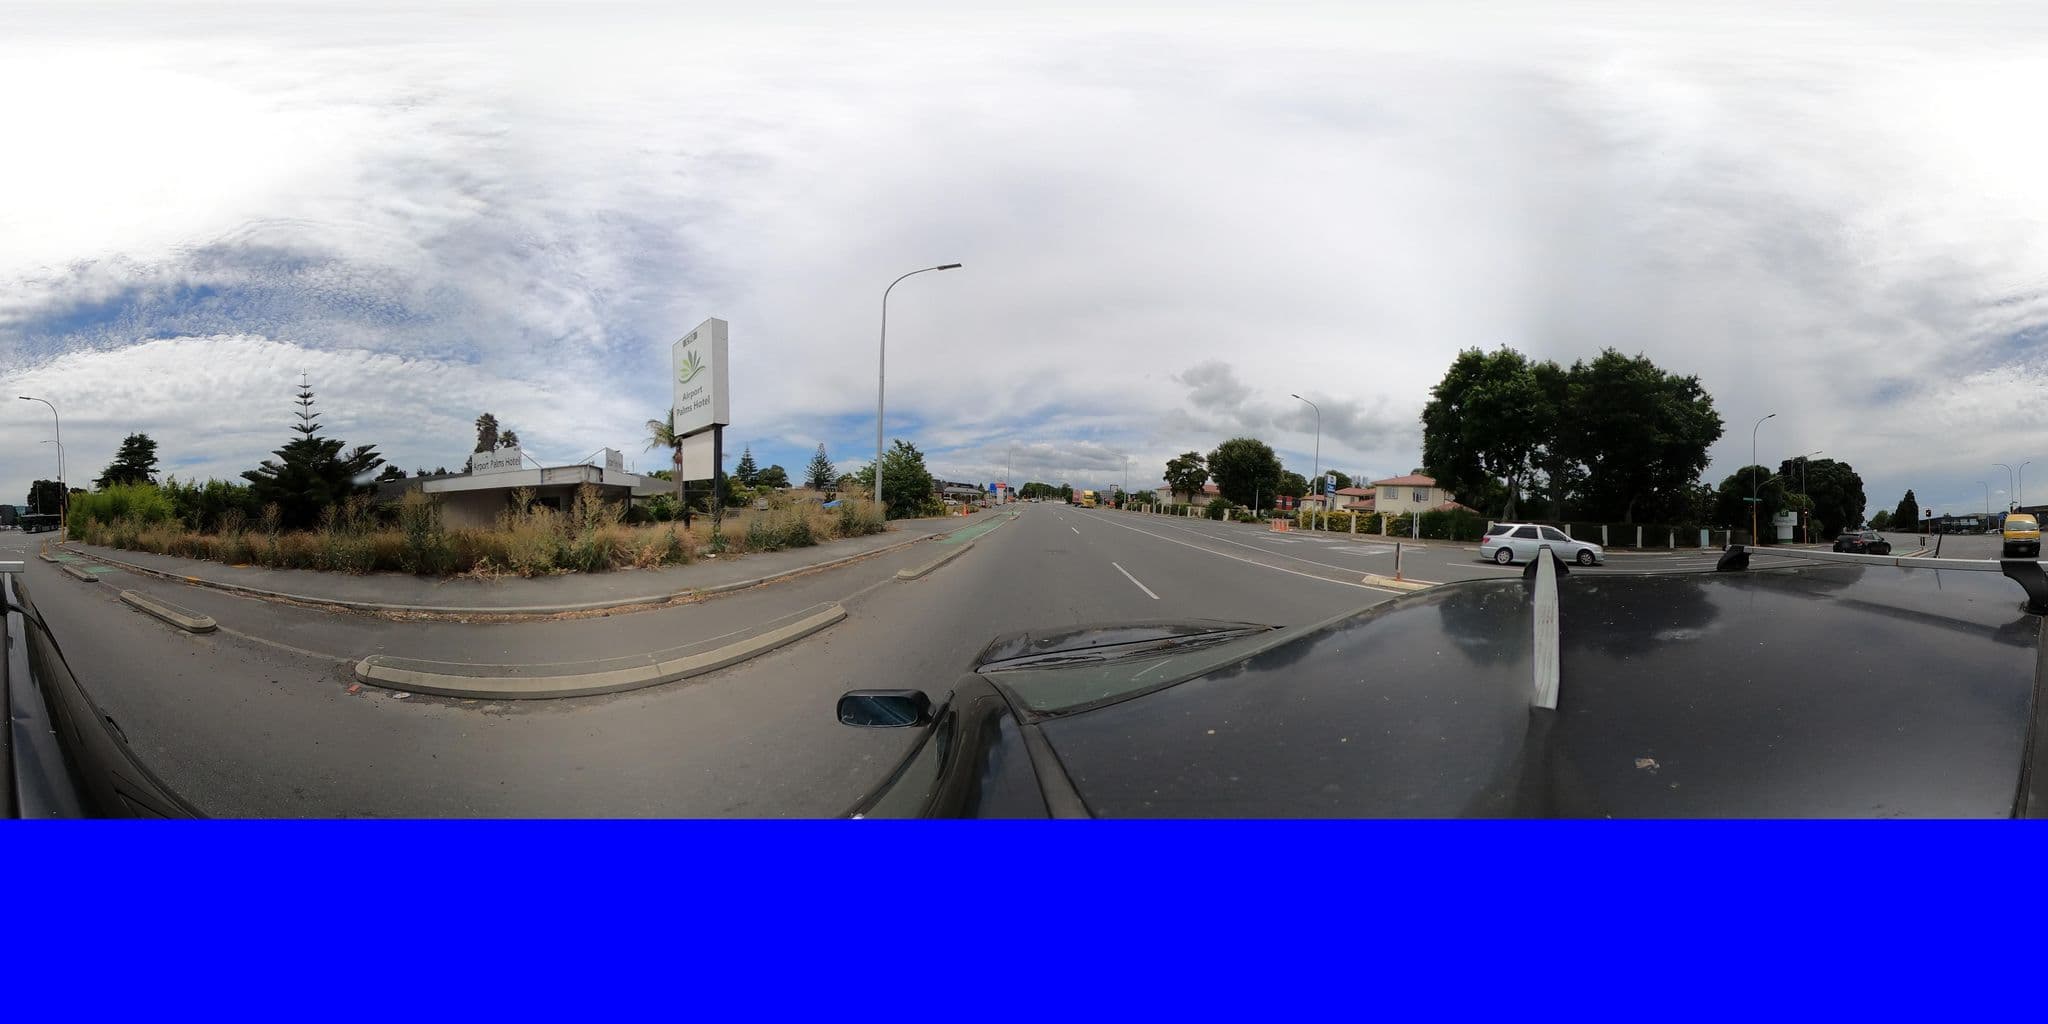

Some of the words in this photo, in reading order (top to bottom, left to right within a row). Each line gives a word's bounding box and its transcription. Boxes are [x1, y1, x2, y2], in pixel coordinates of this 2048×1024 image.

[682, 386, 703, 402] Airport
[676, 404, 693, 416] Palms
[693, 395, 711, 410] Hotel
[473, 462, 489, 471] Airport
[490, 459, 504, 468] Palms
[505, 457, 520, 466] Hotel
